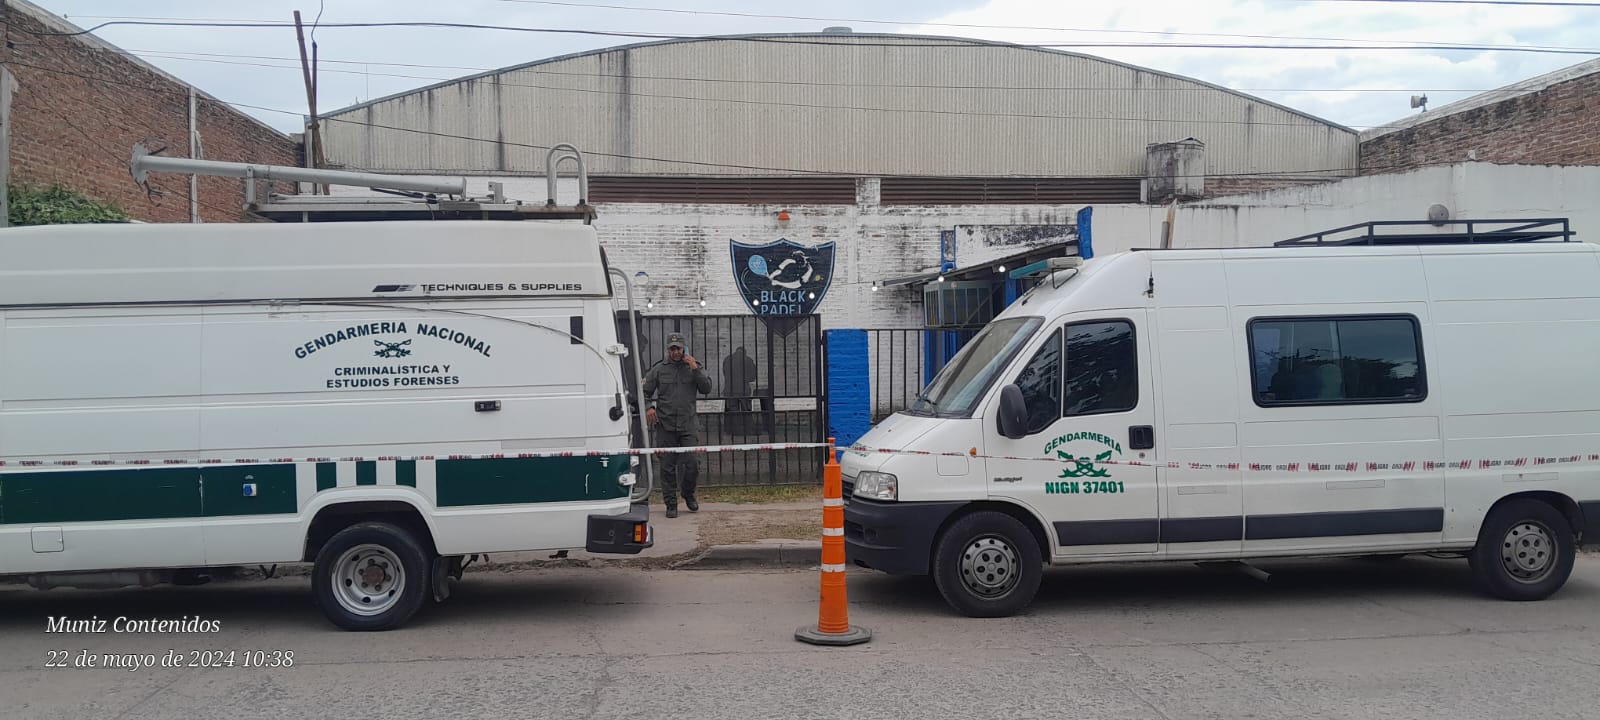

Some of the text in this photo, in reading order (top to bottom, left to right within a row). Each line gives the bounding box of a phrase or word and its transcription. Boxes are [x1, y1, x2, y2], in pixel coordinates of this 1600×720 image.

[420, 282, 583, 292] TECHNIQUES & SUPPLIES
[761, 290, 805, 302] BLACK
[294, 321, 493, 359] GENDARMERIA NACIONAL
[334, 364, 451, 376] CRIMINALÍSTICA Y
[326, 375, 460, 389] ESTUDIOS FORENSES
[1044, 432, 1122, 454] GENDARMERIA
[1045, 481, 1124, 493] NIGN 37401
